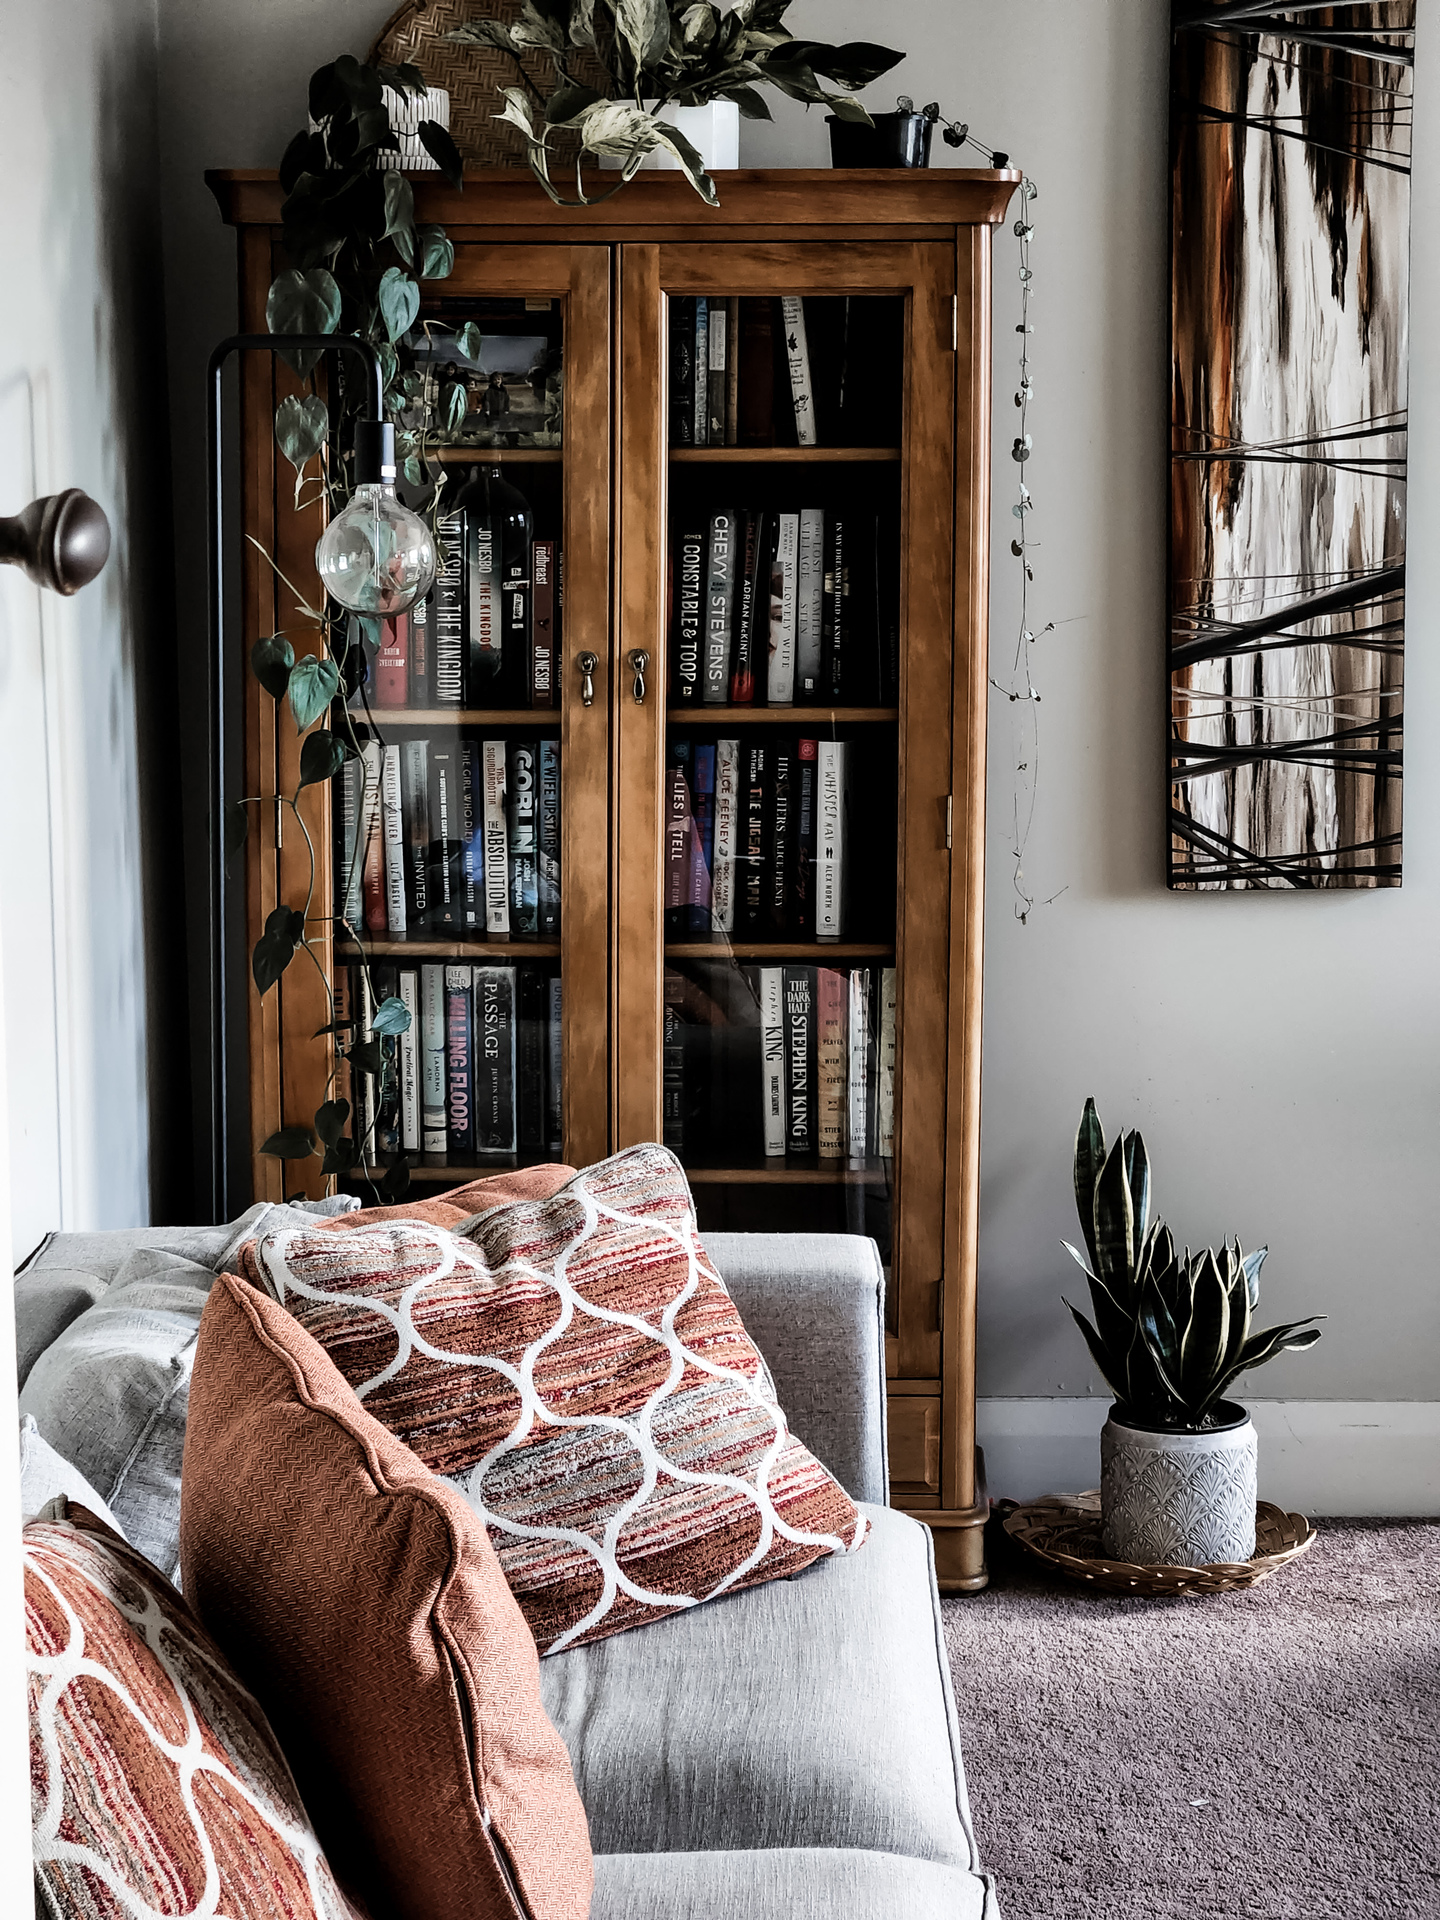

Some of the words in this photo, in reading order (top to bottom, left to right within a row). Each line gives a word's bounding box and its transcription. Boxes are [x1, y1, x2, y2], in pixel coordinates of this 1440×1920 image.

[478, 528, 492, 540] JO
[746, 522, 754, 540] THE
[835, 522, 842, 531] IN
[835, 534, 842, 546] MY
[713, 515, 729, 579] CHEVY
[745, 543, 754, 574] CHAIN
[801, 522, 810, 579] VILLAGE
[812, 542, 821, 575] LOST
[535, 546, 549, 585] redbreast
[784, 562, 793, 579] MY
[480, 582, 491, 600] THE
[681, 544, 700, 626] CONSTABLE
[741, 580, 751, 618] ADRIAN
[437, 605, 461, 630] THE
[782, 586, 792, 631] LOVELY
[800, 603, 808, 635] STEN
[812, 589, 821, 649] CAMILLA
[480, 605, 490, 651] KINGDOM
[682, 629, 696, 638] &
[709, 596, 726, 680] STEVENS
[739, 621, 749, 662] McKINTY
[535, 646, 550, 658] JO
[679, 642, 697, 681] TOOP
[781, 638, 790, 669] WIFE
[437, 636, 461, 700] KINGDOM
[535, 660, 549, 690] NESBØ
[461, 749, 470, 765] THE
[544, 748, 555, 763] THE
[778, 757, 788, 779] HIS
[386, 755, 396, 807] UNRAVELING
[439, 777, 448, 804] SOUTHERN
[462, 769, 471, 791] GIRL
[496, 766, 504, 785] YRSA
[543, 766, 556, 796] WIFE
[721, 759, 731, 794] ALICE
[776, 782, 789, 795] &
[801, 768, 812, 796] CATHERINE
[365, 776, 378, 807] LOST
[463, 793, 472, 818] WHO
[513, 750, 533, 854] GOBLIN
[674, 783, 685, 810] LIES
[749, 787, 763, 810] THE
[801, 797, 810, 810] RYAN
[824, 771, 837, 819] WHISPER
[387, 810, 398, 839] OLIVER
[440, 804, 448, 818] BOOK
[488, 821, 499, 829] THE
[544, 799, 557, 853] UPSTAIRS
[720, 798, 730, 845] FEENEY
[776, 797, 788, 832] HERS
[801, 811, 810, 835] HOWARD
[366, 812, 380, 841] MAN
[441, 819, 449, 836] CLUB'S
[464, 821, 472, 843] DIED
[748, 817, 762, 866] JIGSAW
[824, 822, 834, 841] MAN
[671, 833, 683, 860] TELL
[776, 838, 785, 868] ALICE
[800, 847, 807, 863] 56
[371, 868, 379, 895] HARPER
[390, 862, 400, 875] LIZ
[487, 830, 505, 909] ABSOLUTION
[515, 858, 523, 909] MALERMAN
[523, 858, 531, 881] JOSH
[796, 866, 810, 900] Days
[825, 865, 833, 882] ALEX
[391, 879, 400, 909] NUGENT
[415, 861, 426, 909] INVITED
[747, 875, 760, 906] MAN
[774, 871, 784, 908] FEENEY
[787, 992, 811, 1003] DARK
[789, 981, 808, 991] THE
[554, 986, 562, 1023] UNDER
[768, 981, 776, 1022] stephen
[788, 1002, 810, 1013] HALF
[449, 996, 466, 1067] KILLING
[484, 983, 498, 1059] PASSAGE
[666, 1007, 674, 1043] BINDING
[765, 1026, 783, 1062] KING
[791, 1016, 807, 1094] STEPHEN
[404, 1047, 412, 1078] Practical
[405, 1078, 413, 1102] Magic
[770, 1076, 779, 1094] DOLORES
[449, 1072, 468, 1131] FLOOR
[792, 1095, 806, 1137] KING
